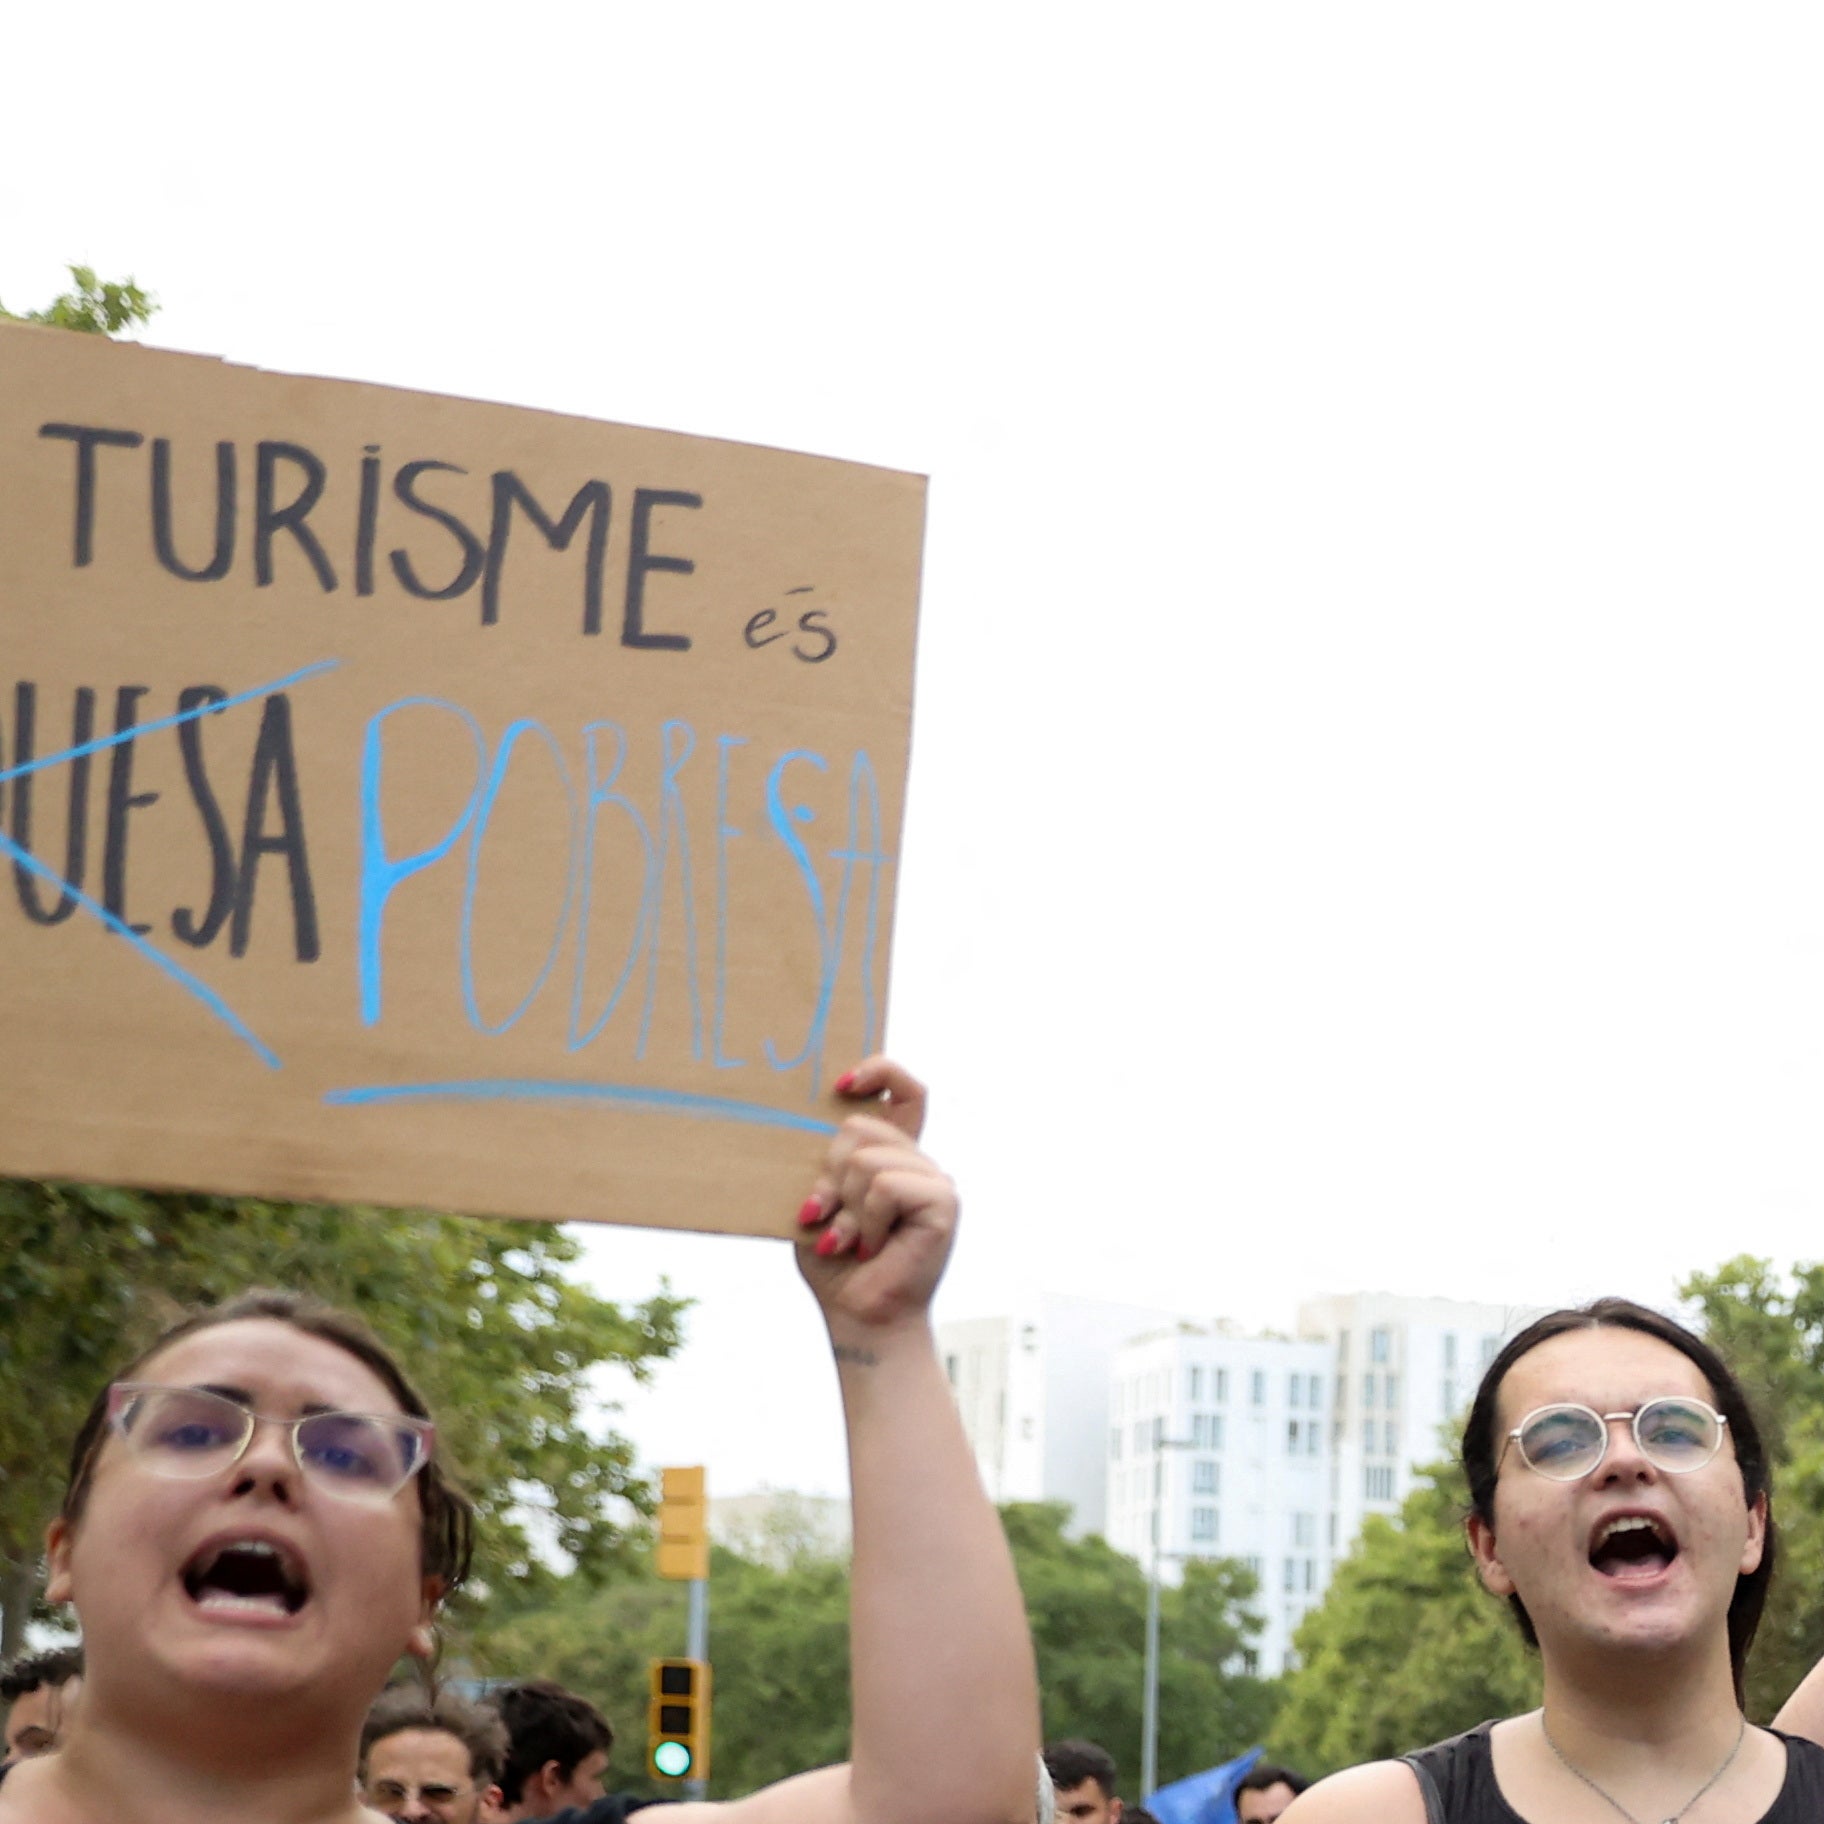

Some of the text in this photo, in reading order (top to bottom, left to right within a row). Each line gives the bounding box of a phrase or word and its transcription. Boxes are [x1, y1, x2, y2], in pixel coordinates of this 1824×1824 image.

[743, 586, 839, 663] és
[0, 681, 890, 1099] UESA POBRESA
